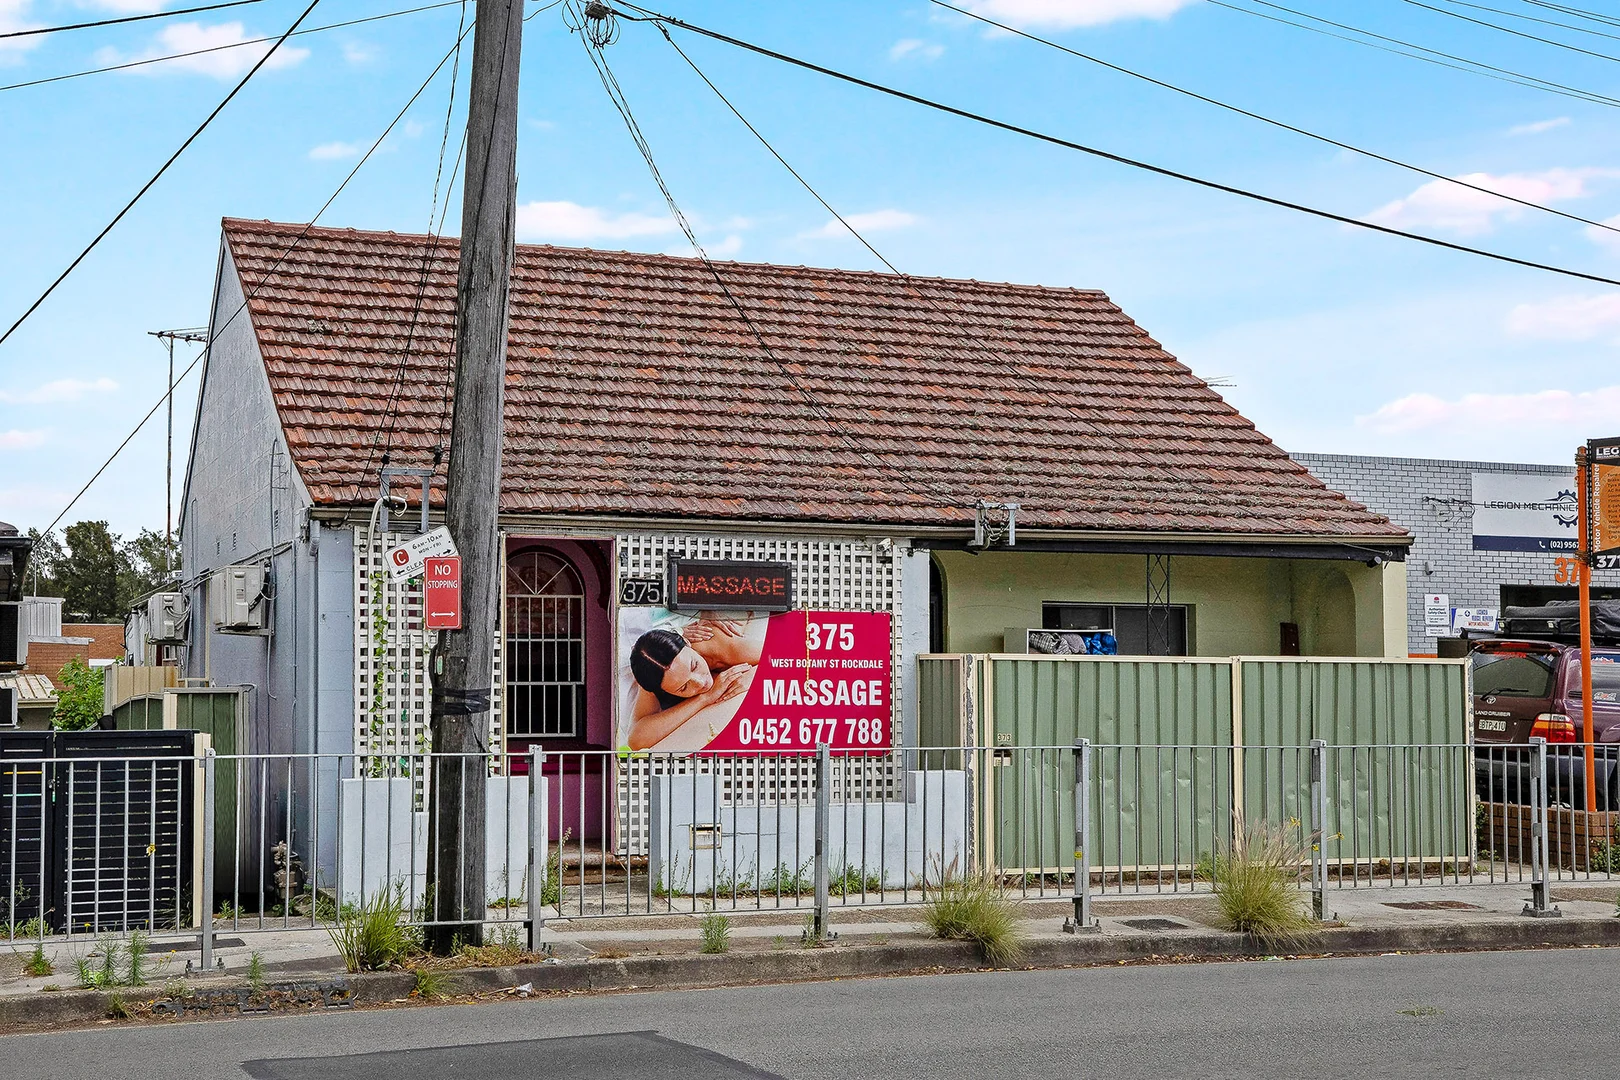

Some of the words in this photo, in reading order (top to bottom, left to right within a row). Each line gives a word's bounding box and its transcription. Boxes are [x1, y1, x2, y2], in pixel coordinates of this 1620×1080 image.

[1484, 501, 1521, 510] LEGION
[1550, 541, 1563, 550] (02)
[1594, 529, 1602, 552] Motor
[396, 551, 407, 564] C
[434, 564, 452, 576] NO
[427, 580, 458, 589] STOPPING
[677, 575, 785, 596] MASSAGE
[623, 581, 660, 603] 375
[807, 622, 855, 651] 375
[770, 658, 794, 668] WEST
[796, 658, 828, 669] BOTANY
[829, 659, 840, 669] ST
[841, 659, 884, 669] ROCKDALE
[763, 679, 883, 706] MASSAGE
[739, 718, 792, 745] 0452
[799, 718, 838, 744] 677
[845, 718, 883, 744] 788
[997, 733, 1012, 742] 373
